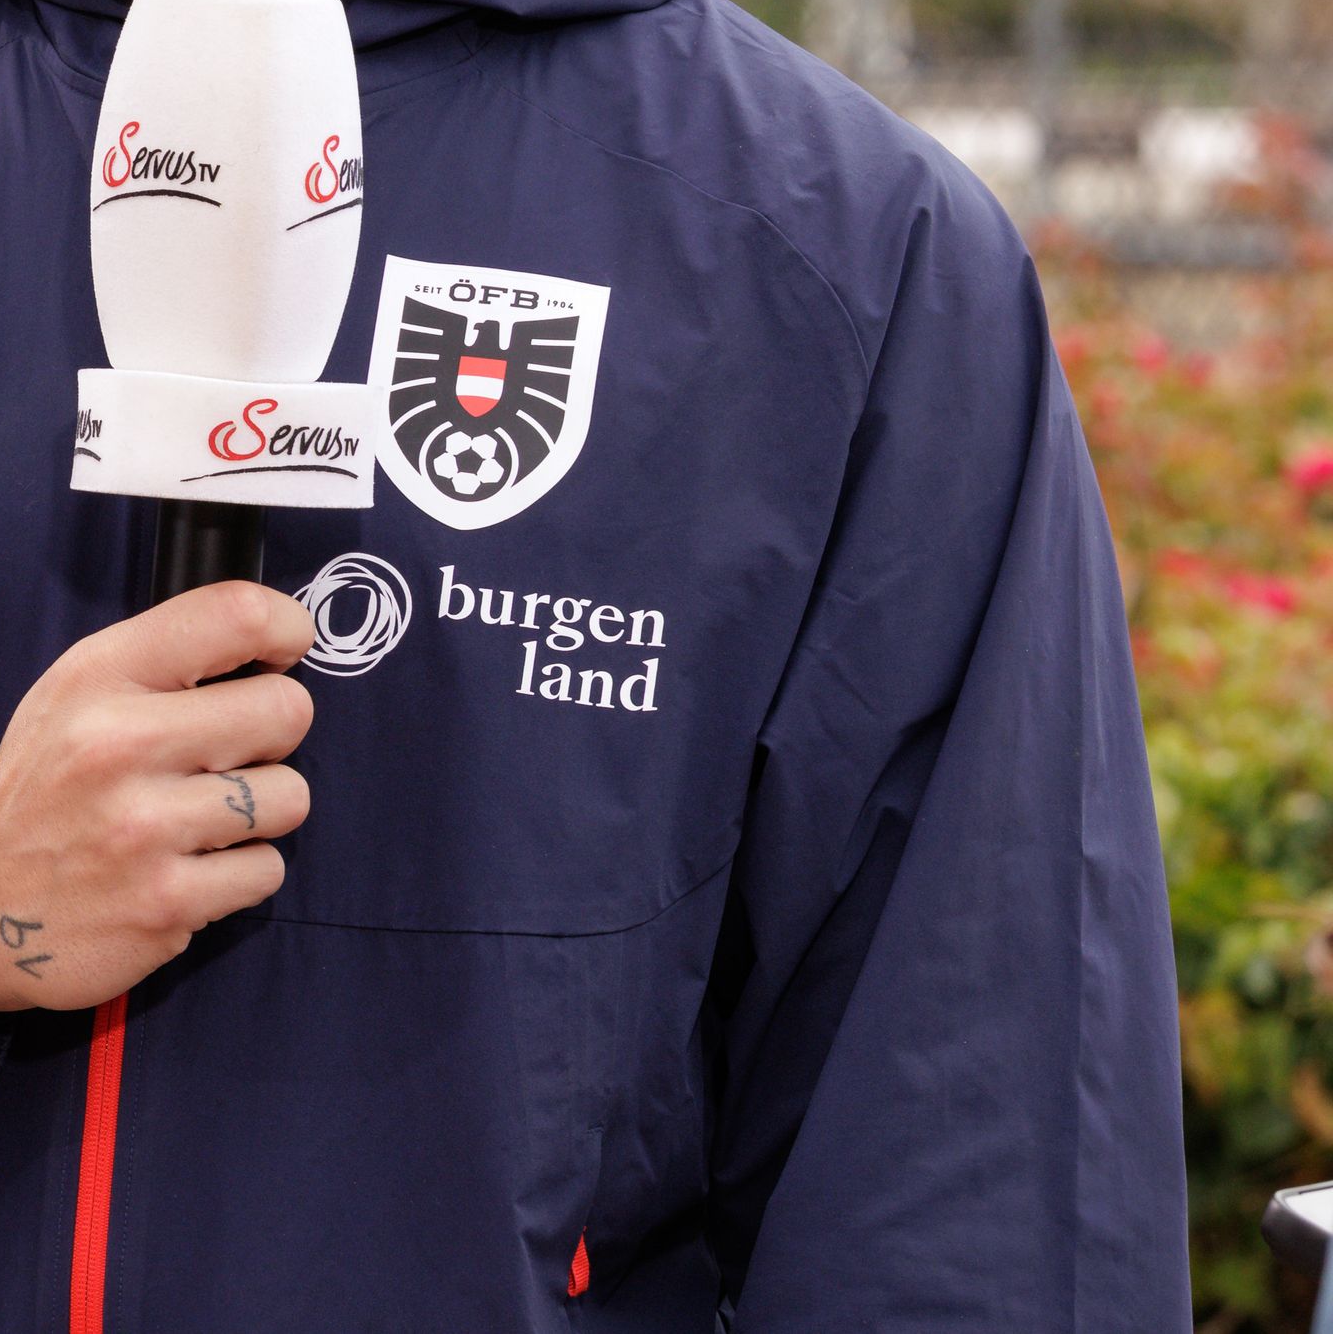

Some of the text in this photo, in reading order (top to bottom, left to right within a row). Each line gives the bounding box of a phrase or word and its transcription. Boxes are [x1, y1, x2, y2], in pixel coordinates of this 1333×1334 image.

[414, 279, 575, 310] SEIT ÖFB 1904
[439, 565, 665, 652] burgen
[516, 641, 658, 713] land
[0, 914, 53, 978] 19
